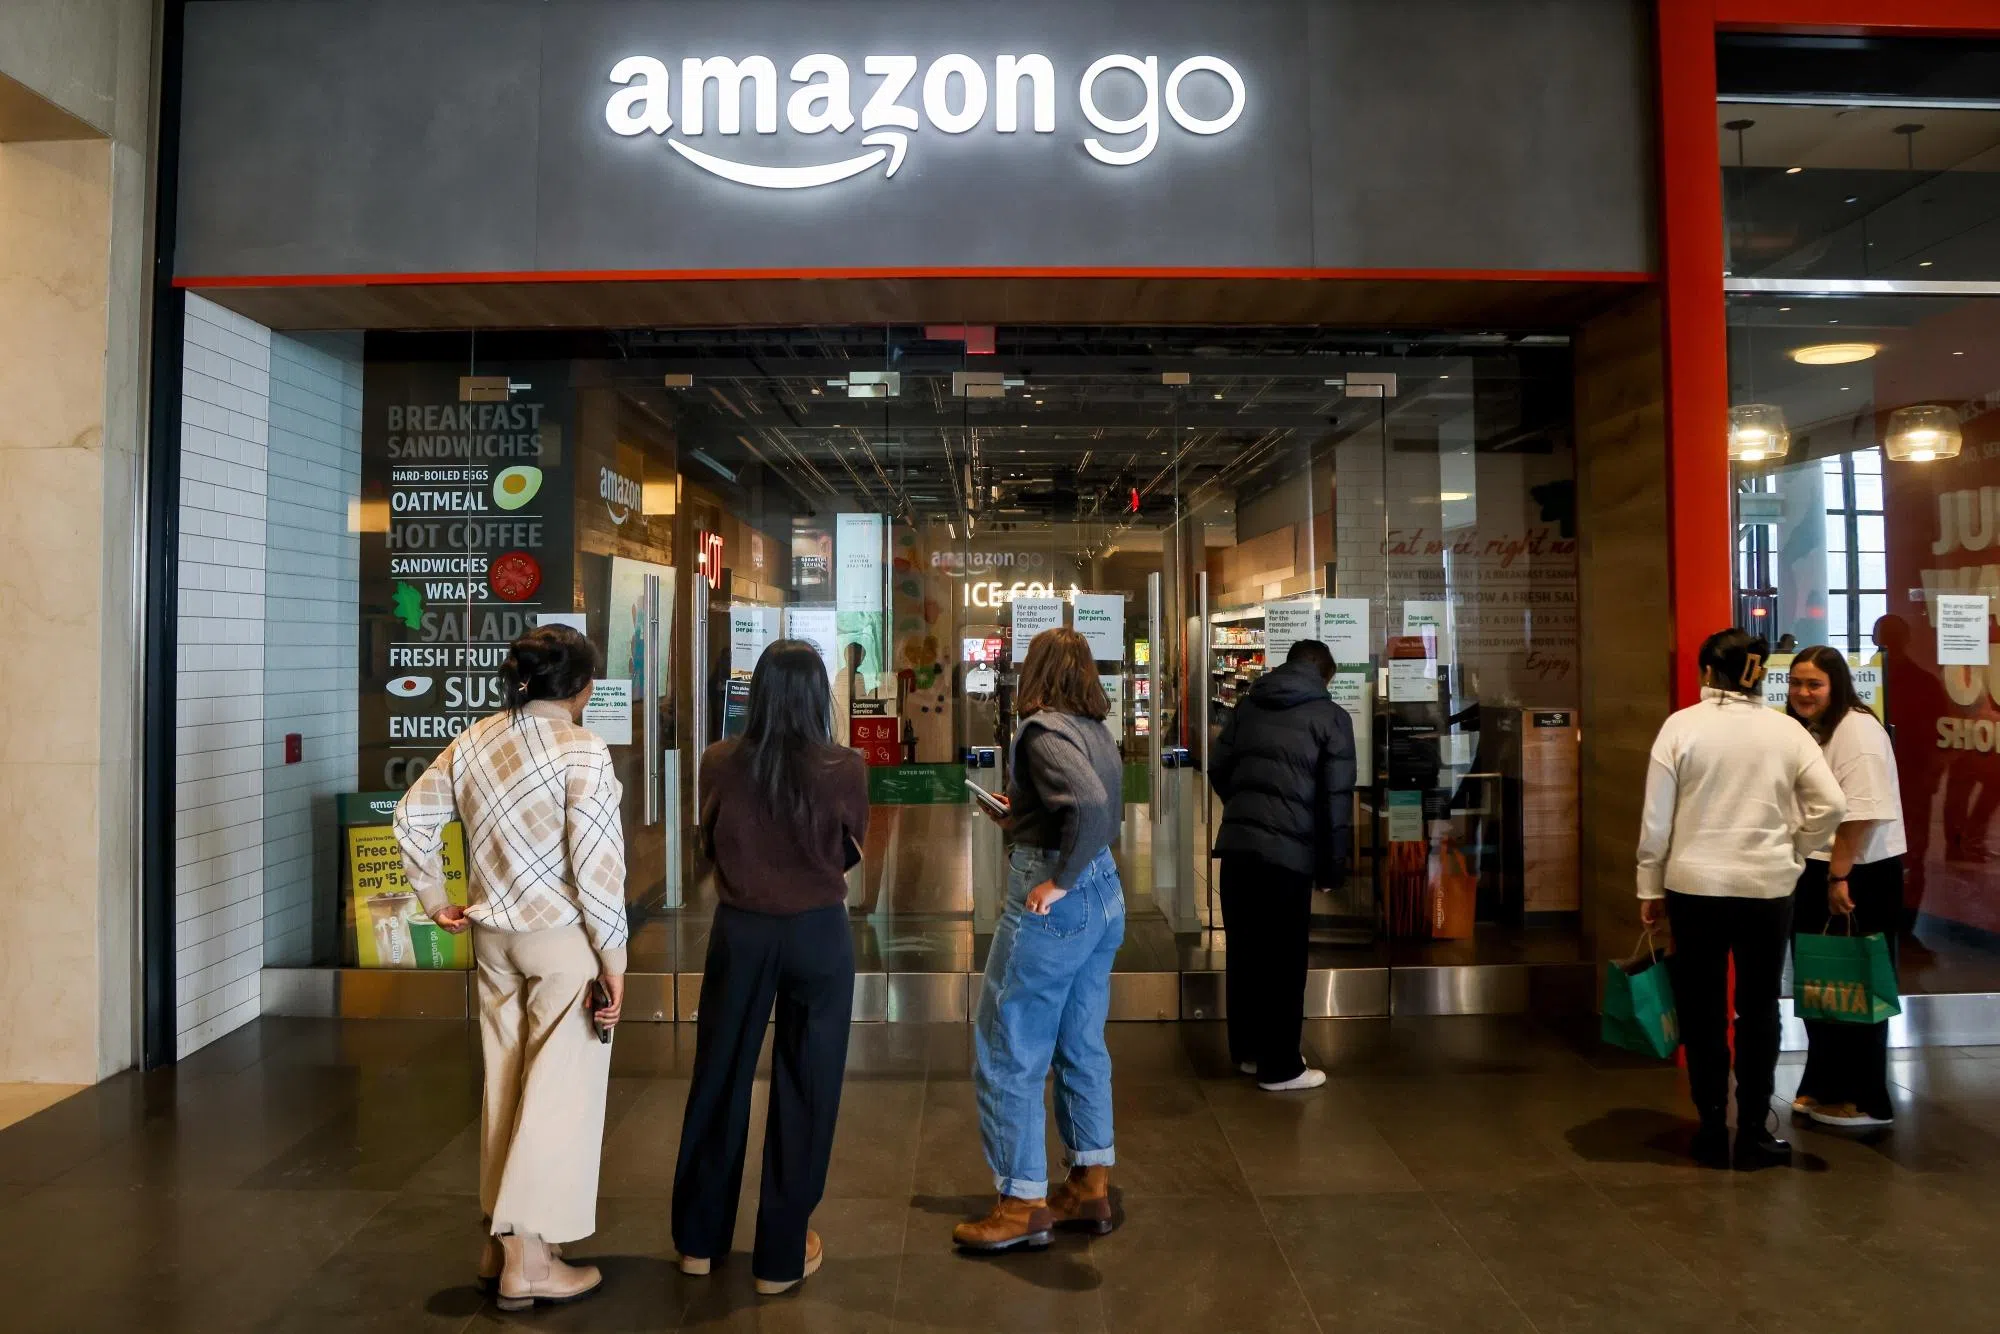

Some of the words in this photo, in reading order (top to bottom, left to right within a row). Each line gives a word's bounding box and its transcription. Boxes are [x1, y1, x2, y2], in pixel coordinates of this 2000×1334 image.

[605, 53, 1055, 136] amazon
[1079, 53, 1246, 166] go
[388, 403, 544, 431] BREAKFAST
[387, 434, 543, 458] SANDWICHES
[392, 470, 460, 481] HARD-BOILED
[462, 469, 488, 481] EGGS
[600, 466, 641, 512] amazon
[391, 491, 488, 512] OATMEAL
[1932, 486, 2000, 555] JU
[385, 523, 441, 549] HOT
[447, 522, 543, 548] COFFEE
[1380, 528, 1424, 556] Eat
[1484, 527, 1550, 569] right
[391, 557, 488, 573] SANDWICHES
[699, 530, 723, 589] HOT
[425, 582, 488, 600] WRAPS
[964, 582, 1003, 607] ICE
[1513, 592, 1552, 602] FRESH
[1028, 622, 1040, 630] day.
[390, 648, 449, 667] FRESH
[356, 845, 387, 858] Free
[358, 876, 383, 889] any
[385, 873, 398, 885] $5
[431, 931, 439, 942] go
